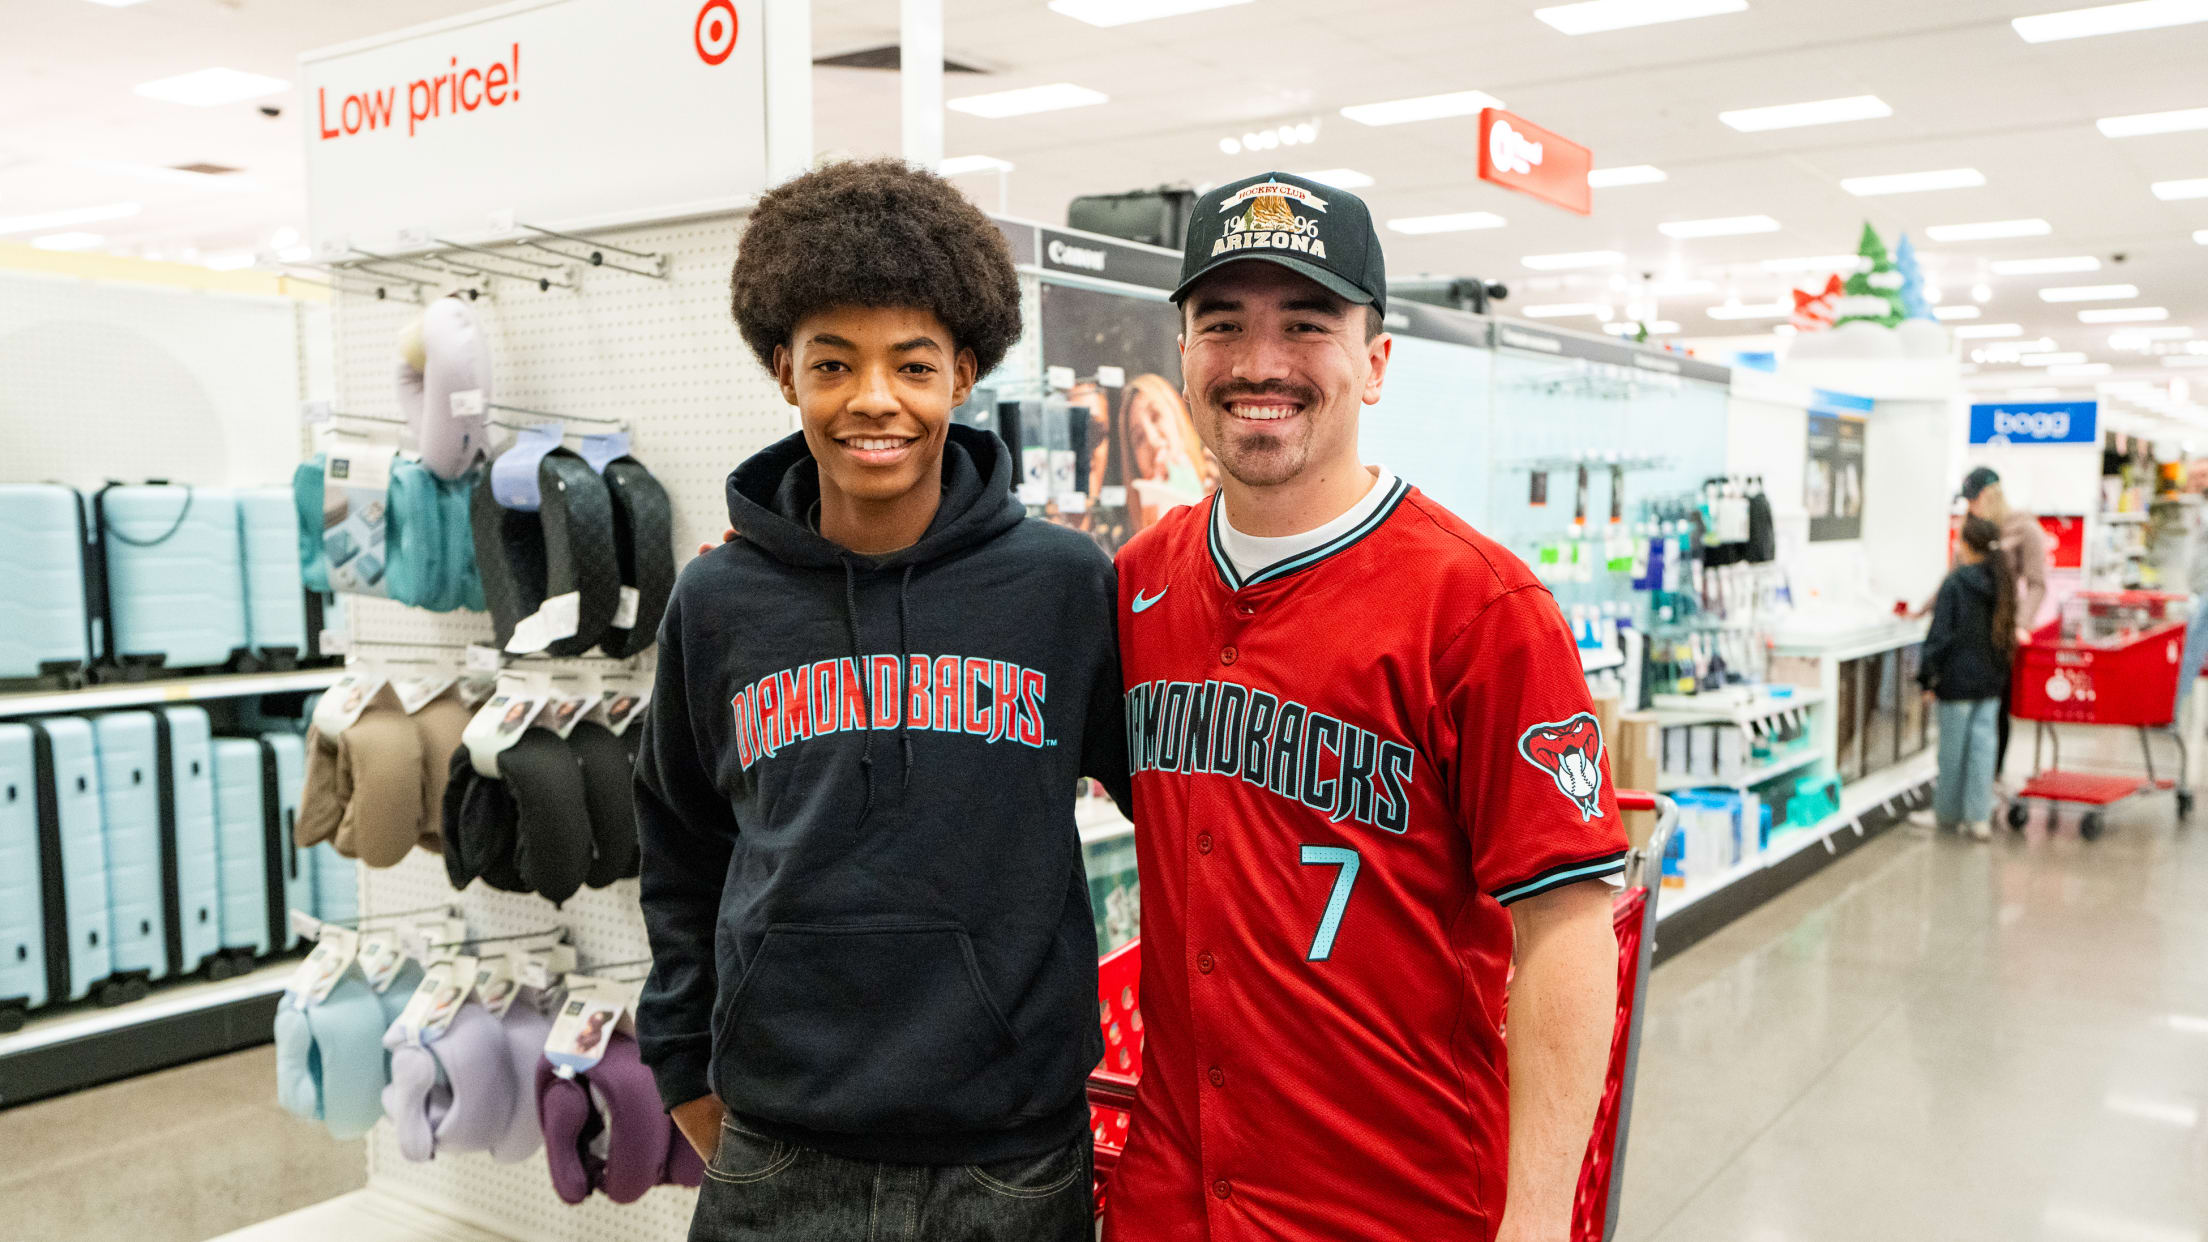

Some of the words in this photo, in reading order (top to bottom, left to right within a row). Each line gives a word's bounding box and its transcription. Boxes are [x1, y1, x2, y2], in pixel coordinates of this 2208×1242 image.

[319, 86, 396, 140] Low
[408, 42, 520, 137] price!
[1238, 186, 1278, 200] HOCKEY
[1279, 186, 1306, 200] CLUB
[1210, 231, 1327, 259] ARIZONA
[1994, 408, 2071, 439] bogg
[731, 653, 1046, 772] DIAMONDBACKS
[1123, 679, 1415, 835] IAMONDBACKS
[1299, 843, 1361, 962] 7
